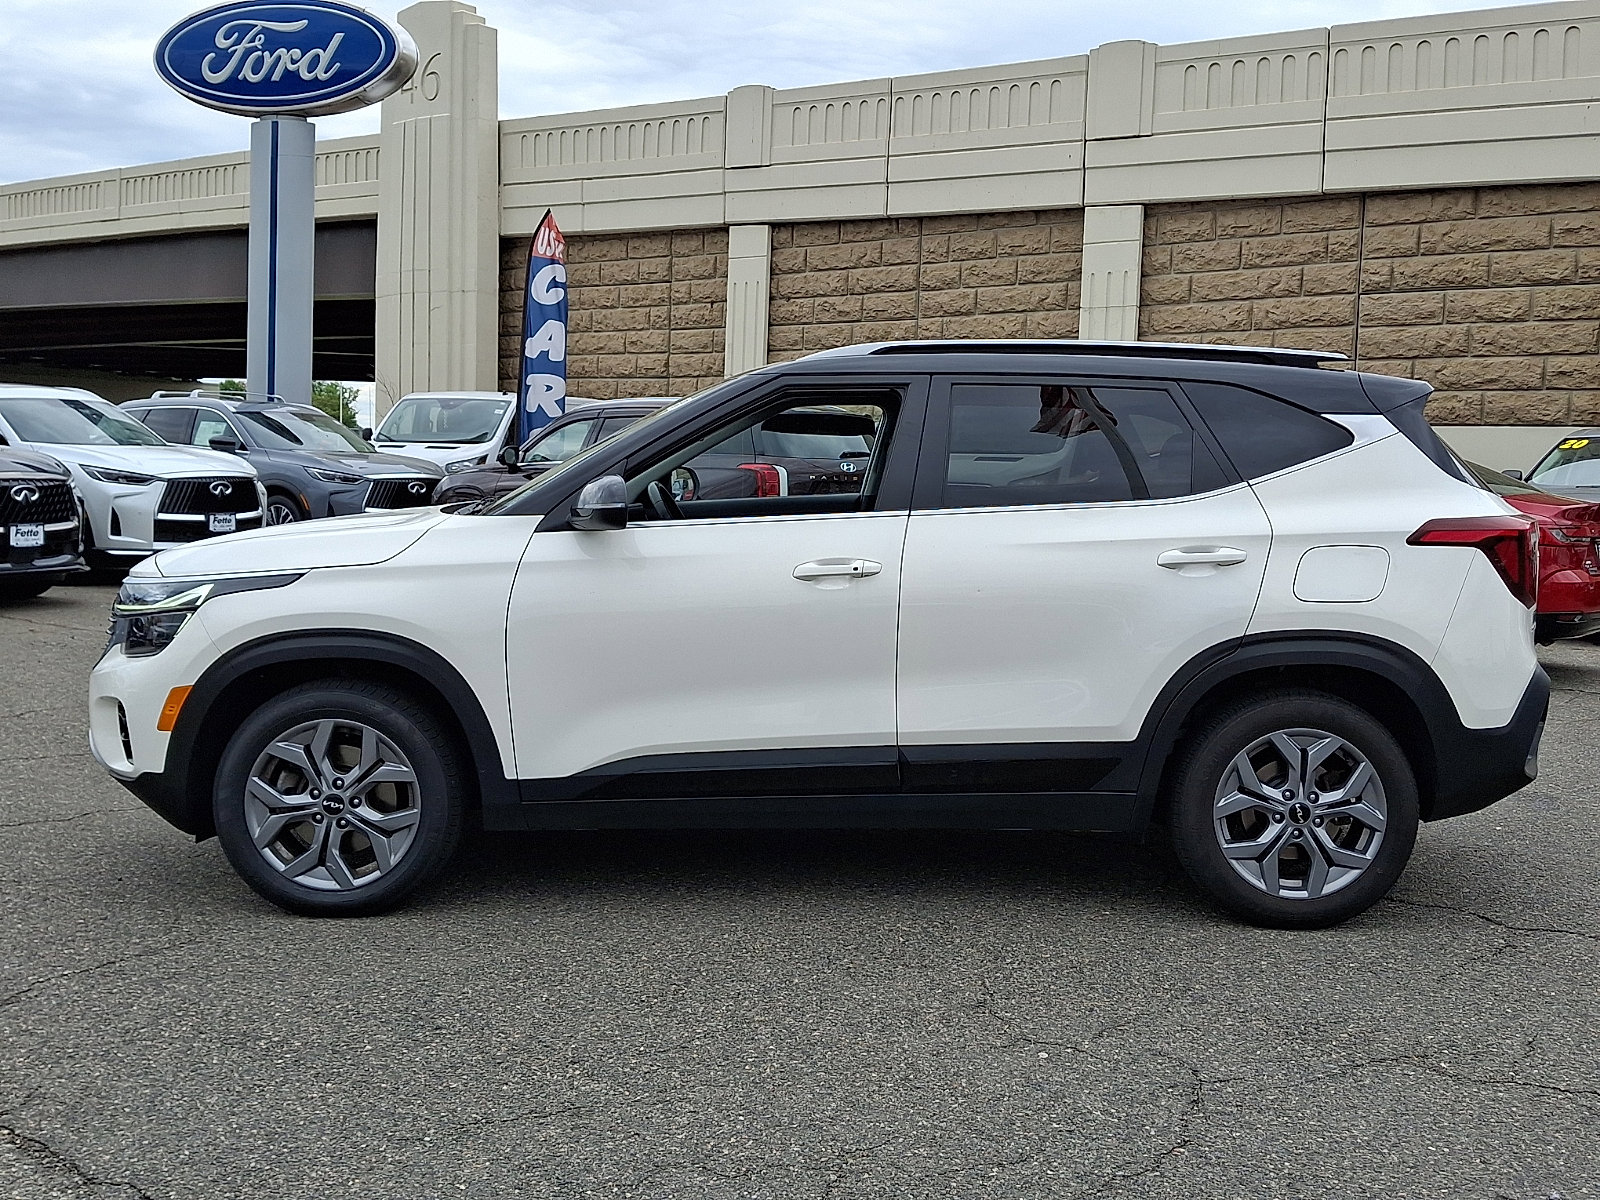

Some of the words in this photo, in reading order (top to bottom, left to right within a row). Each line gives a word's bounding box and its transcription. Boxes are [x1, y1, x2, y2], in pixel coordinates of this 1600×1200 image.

[201, 19, 345, 84] Ford
[525, 264, 567, 440] CAR
[1558, 439, 1589, 449] 20
